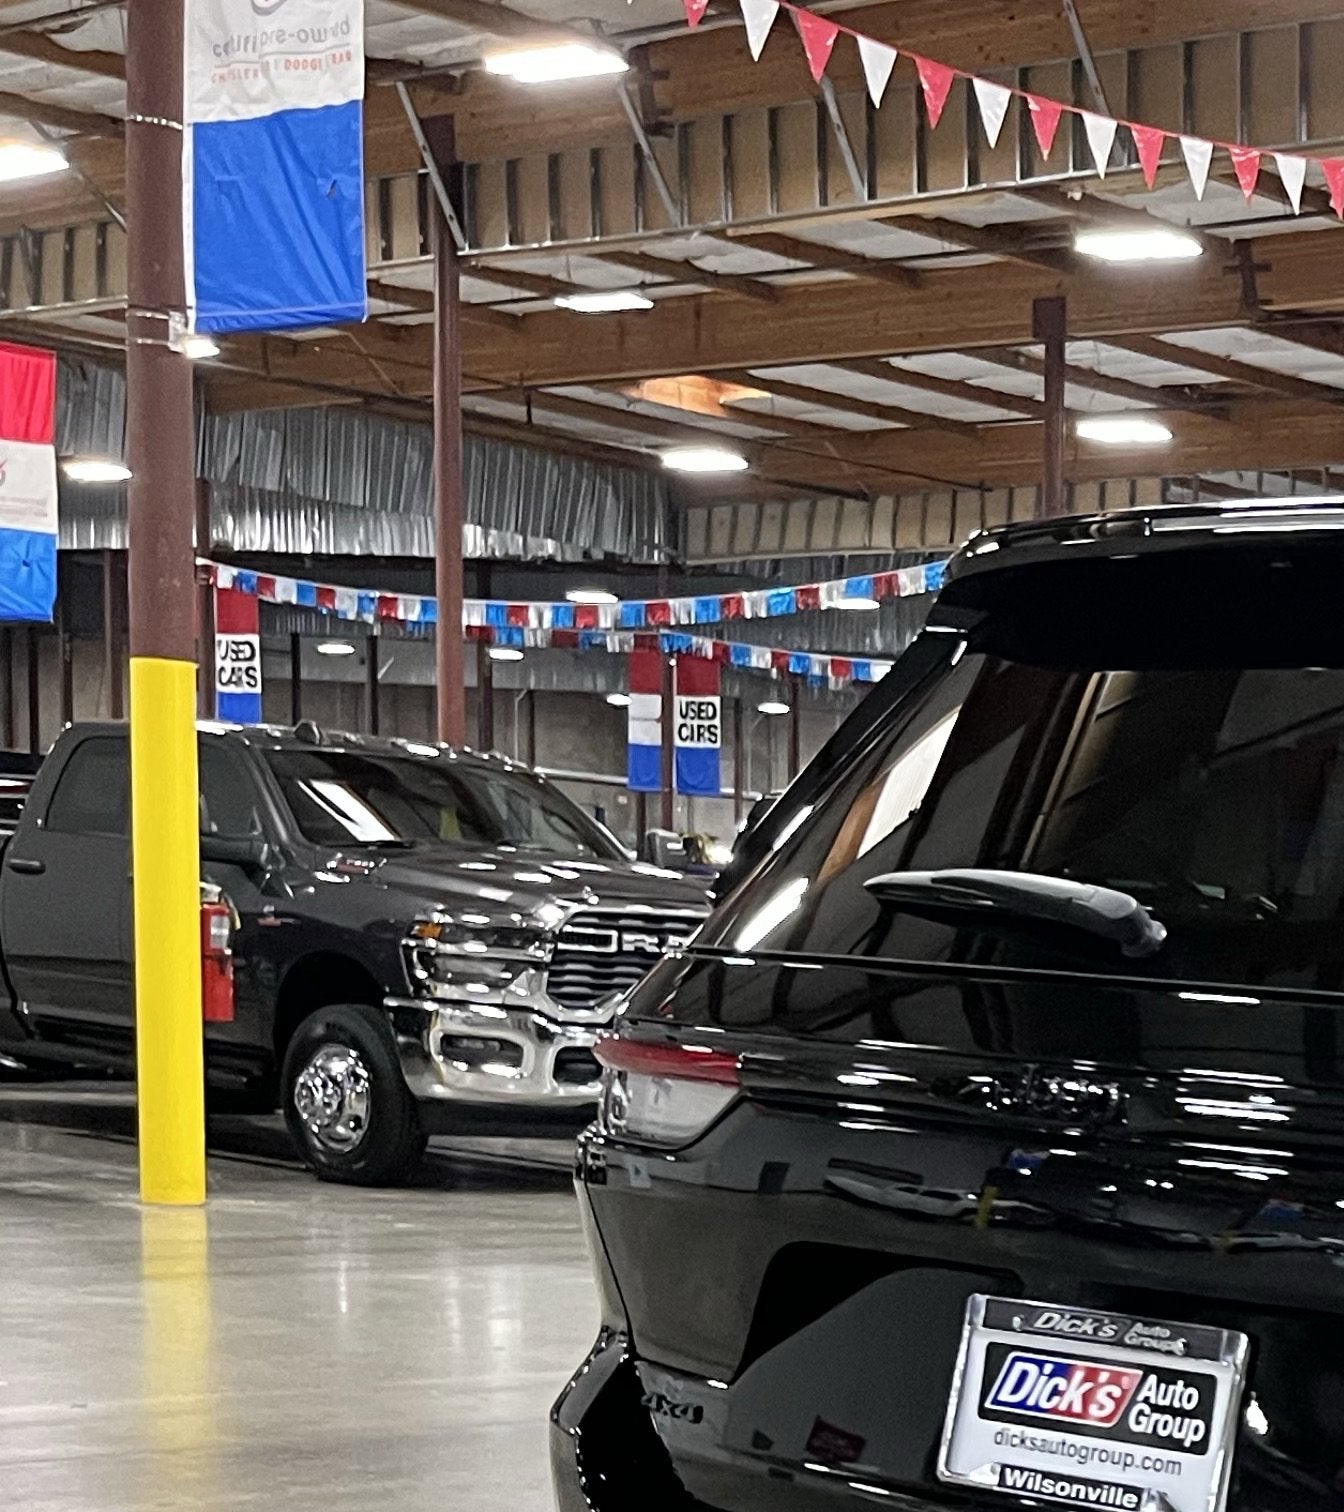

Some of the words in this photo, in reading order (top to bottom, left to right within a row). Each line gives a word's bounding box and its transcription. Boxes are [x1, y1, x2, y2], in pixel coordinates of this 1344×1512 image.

[679, 700, 717, 721] USED
[1033, 1311, 1119, 1338] Dick's
[1131, 1322, 1171, 1339] Auto
[997, 1361, 1122, 1418] Dick's
[1136, 1374, 1199, 1411] Auto
[1128, 1402, 1206, 1448] Group
[993, 1428, 1183, 1476] dicksautogroup.com
[1004, 1467, 1139, 1509] Wilsonville
